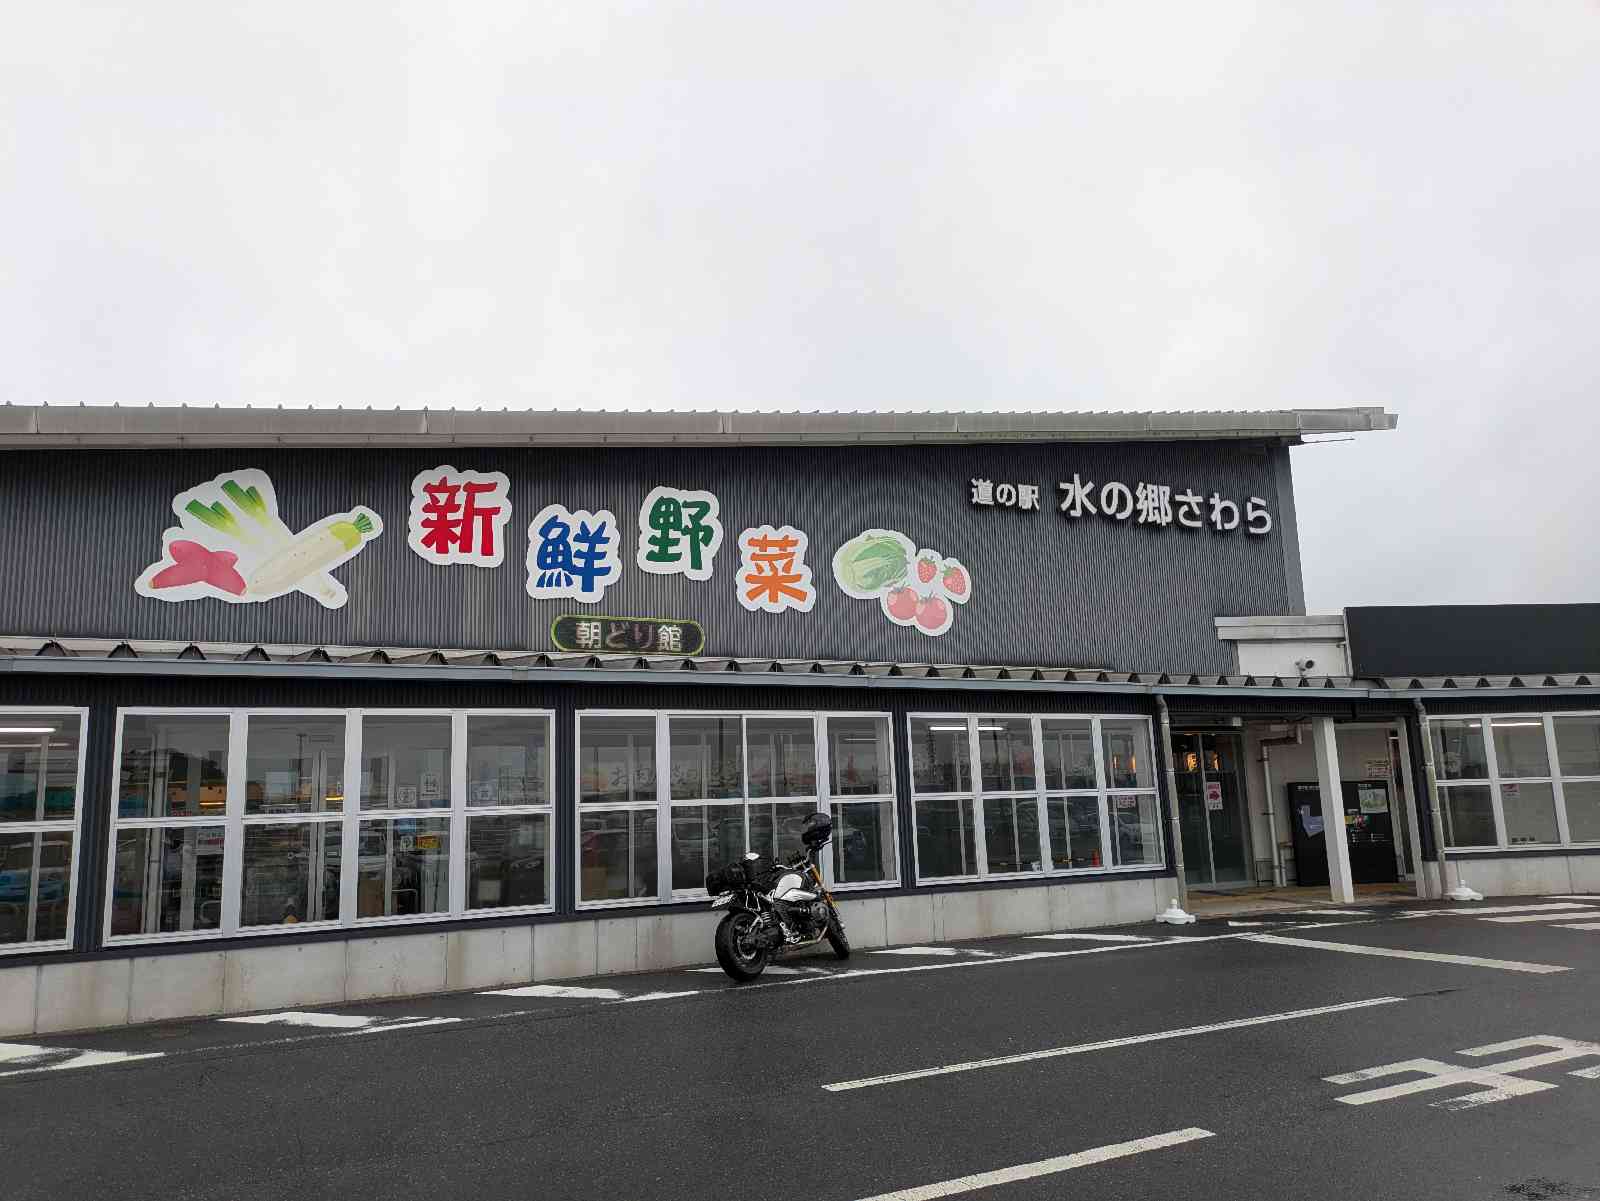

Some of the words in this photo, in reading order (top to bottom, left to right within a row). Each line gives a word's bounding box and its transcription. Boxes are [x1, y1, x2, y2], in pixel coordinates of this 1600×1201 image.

[971, 478, 1040, 511] 道の駅
[1059, 473, 1273, 534] 水の郷さわら
[420, 476, 808, 603] 新鮮野菜
[575, 621, 683, 652] 朝どり館
